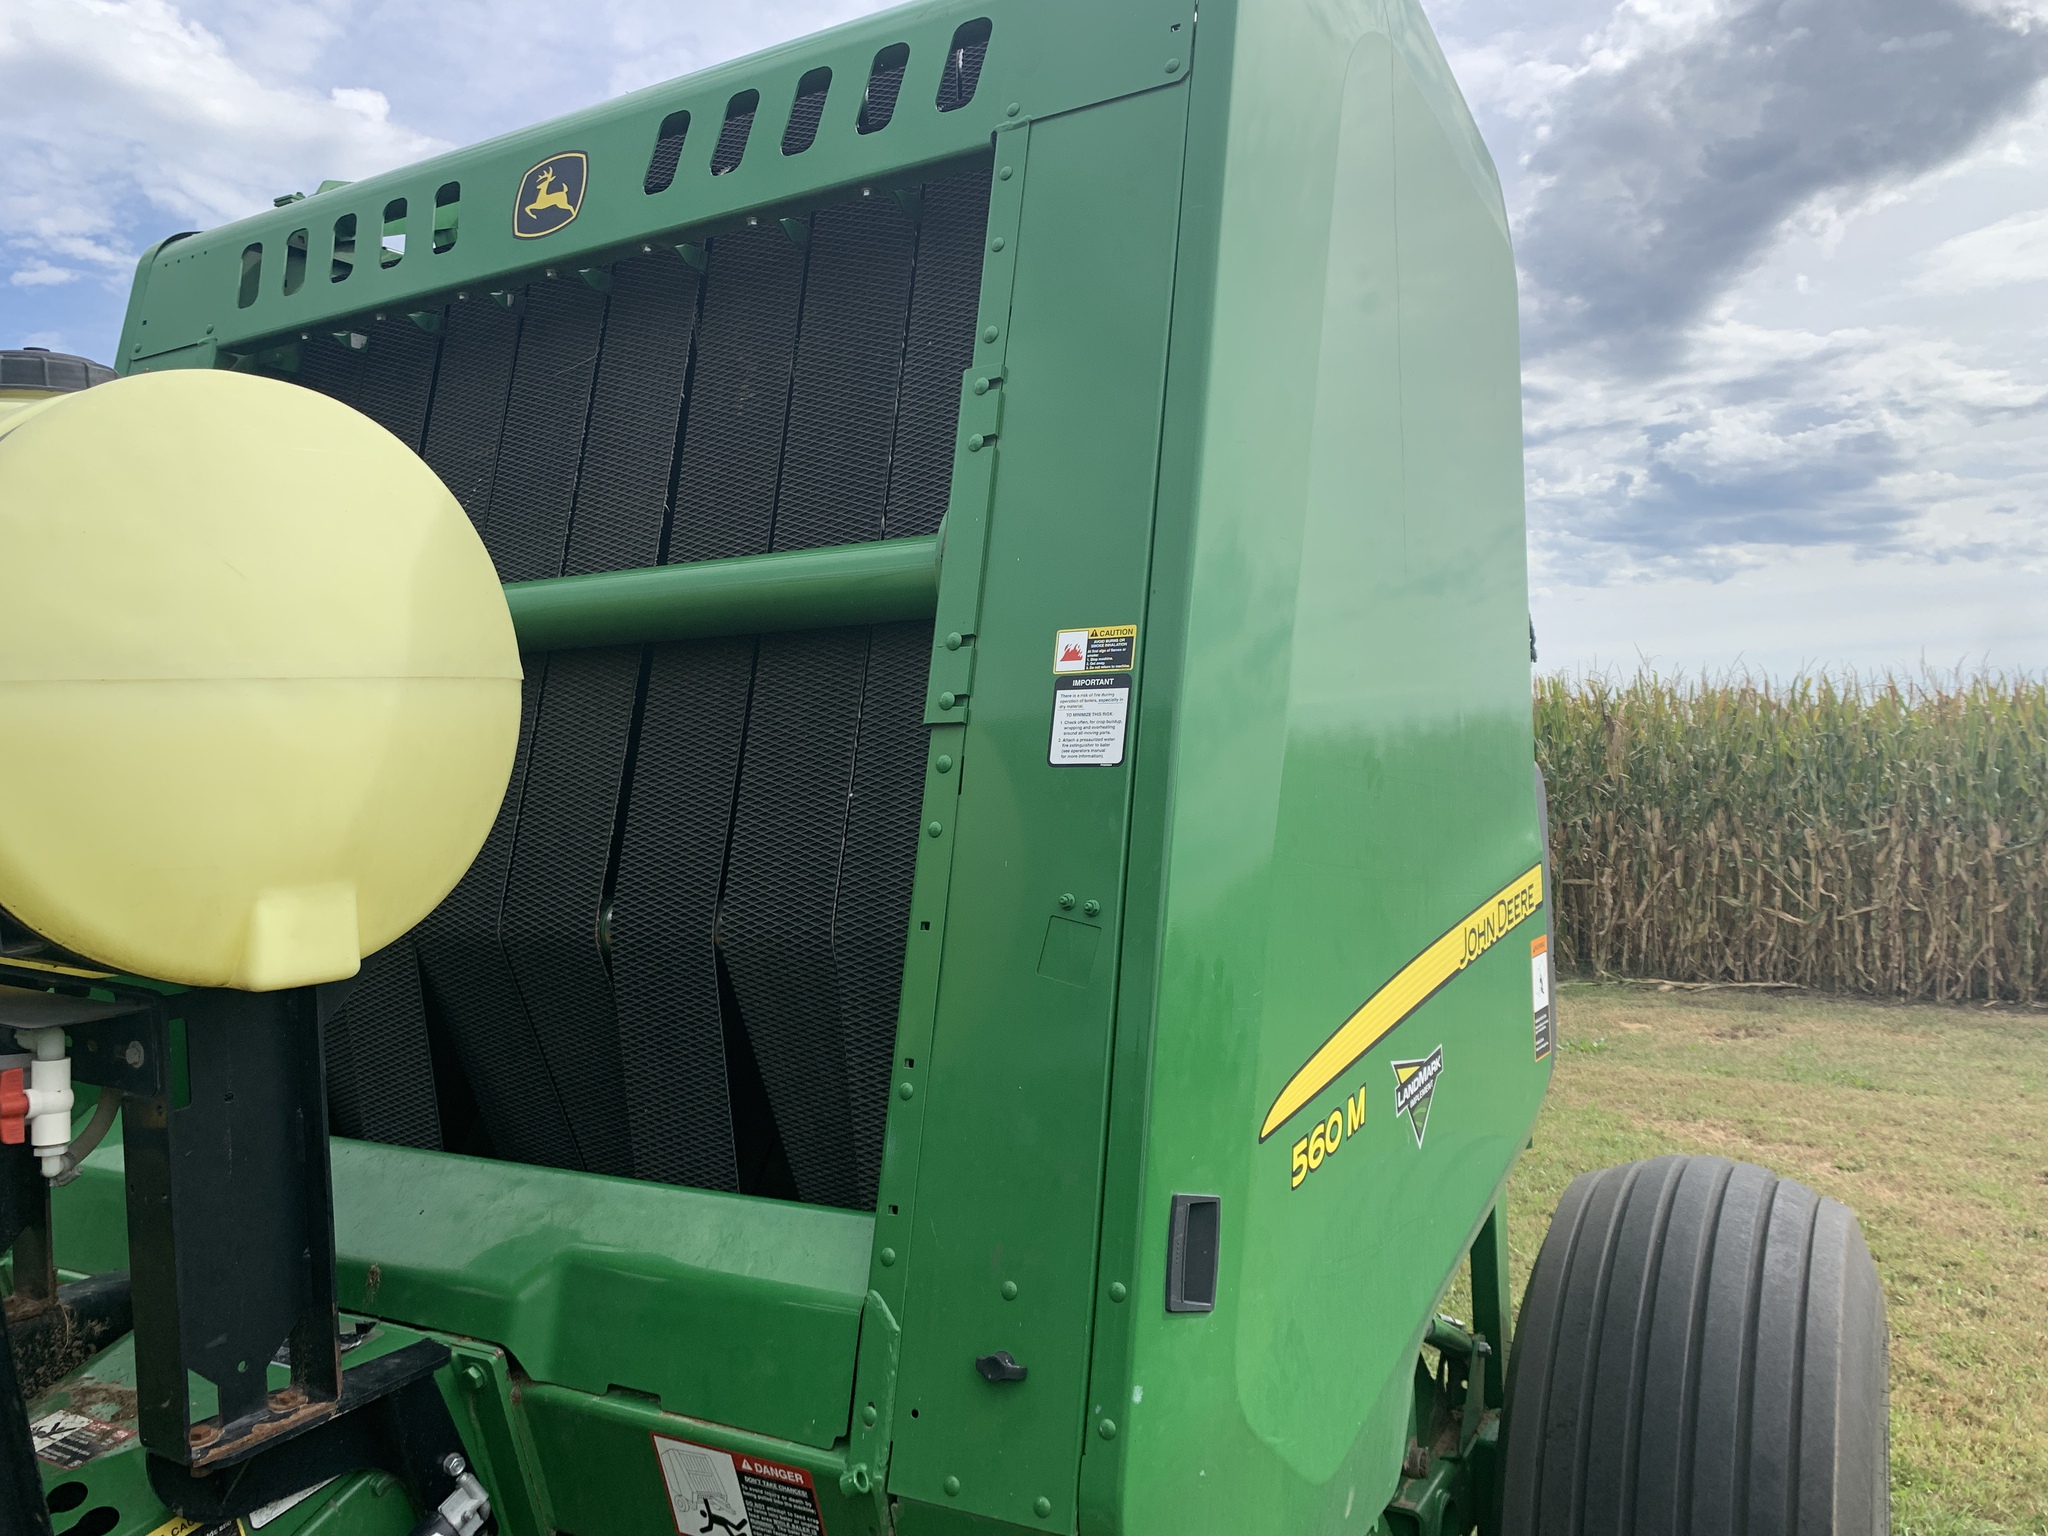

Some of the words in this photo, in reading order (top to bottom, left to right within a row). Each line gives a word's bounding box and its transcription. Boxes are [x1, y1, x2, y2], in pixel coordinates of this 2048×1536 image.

[1100, 629, 1133, 637] CAUTION
[1072, 678, 1114, 686] IMPORTANT
[1460, 912, 1495, 965] JOHN
[1498, 883, 1534, 933] DEERE
[1398, 1055, 1441, 1107] LANDMARK
[1410, 1079, 1434, 1108] IMPLEMENT
[754, 1462, 804, 1484] DANGER
